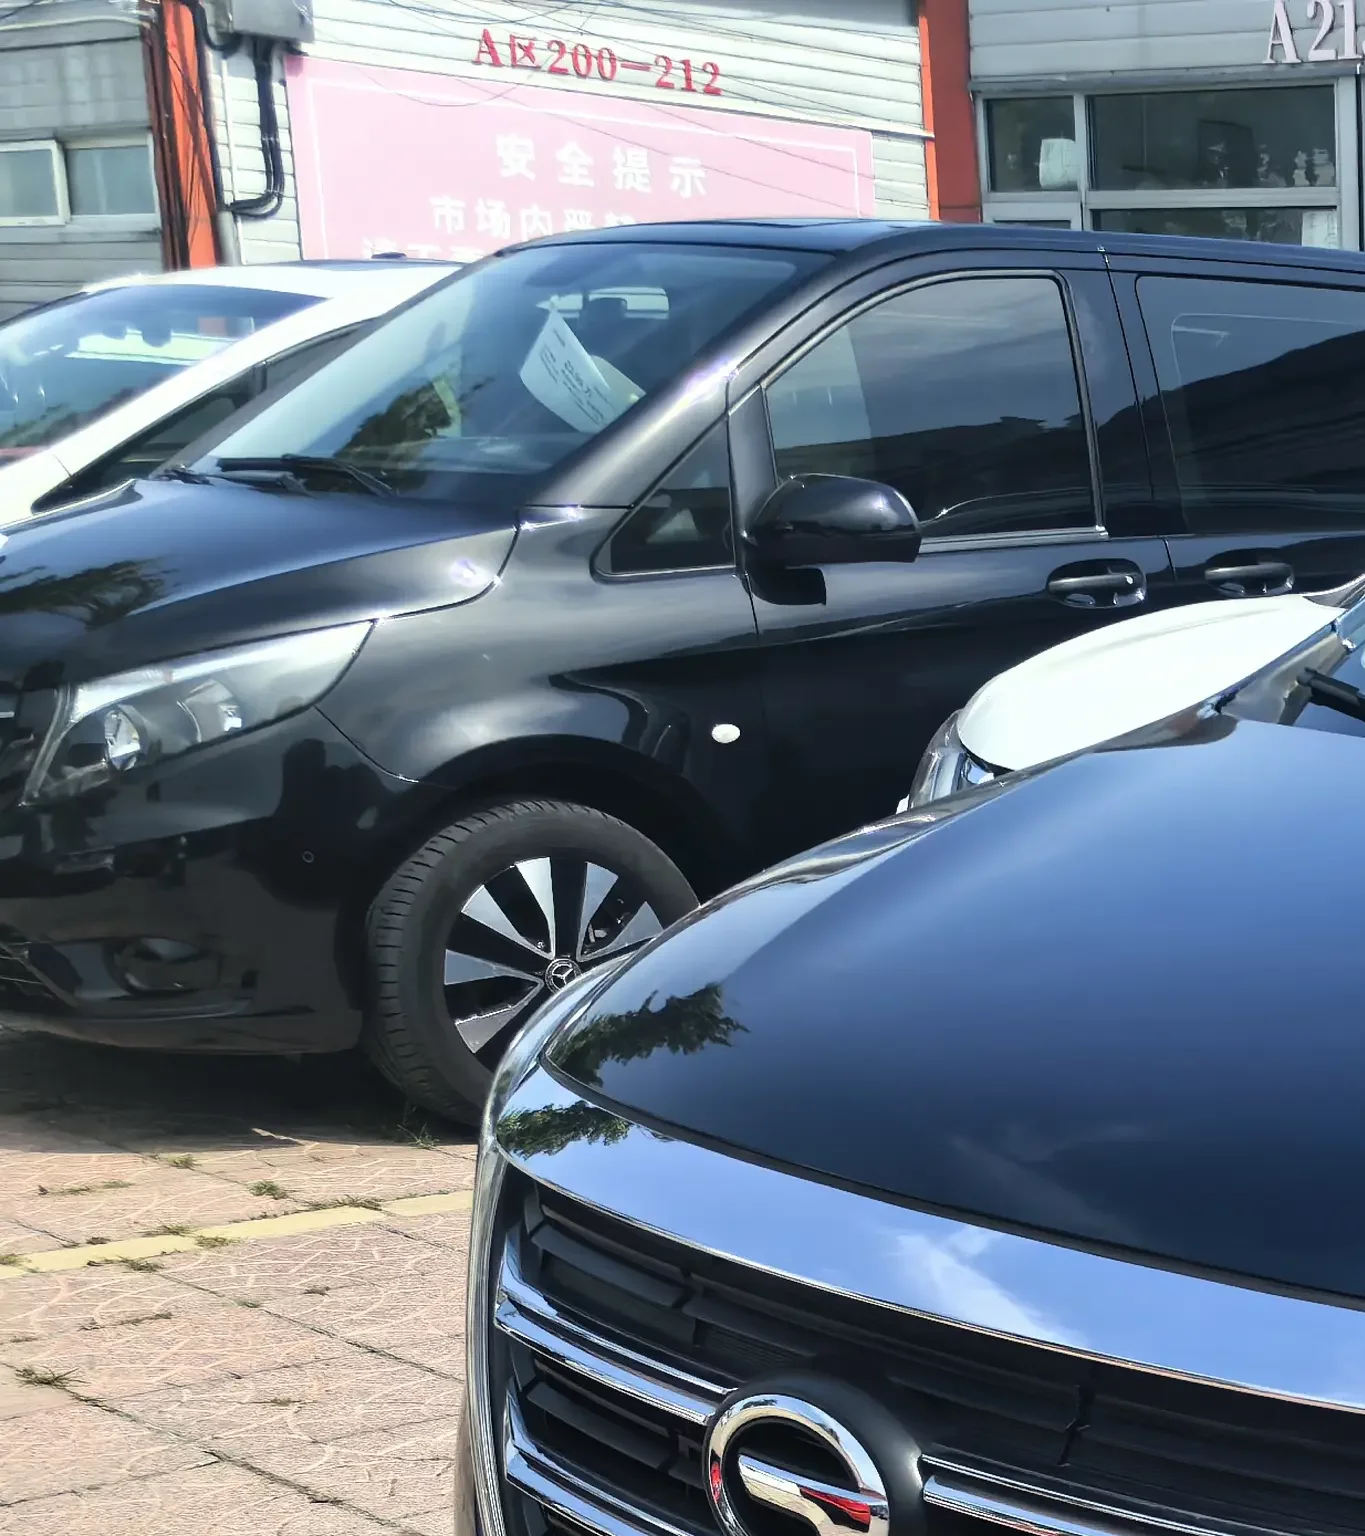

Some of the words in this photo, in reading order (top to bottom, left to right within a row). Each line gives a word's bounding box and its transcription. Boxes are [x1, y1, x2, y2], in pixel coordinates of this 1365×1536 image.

[471, 27, 723, 96] A区200-212
[495, 133, 707, 199] 安全提示
